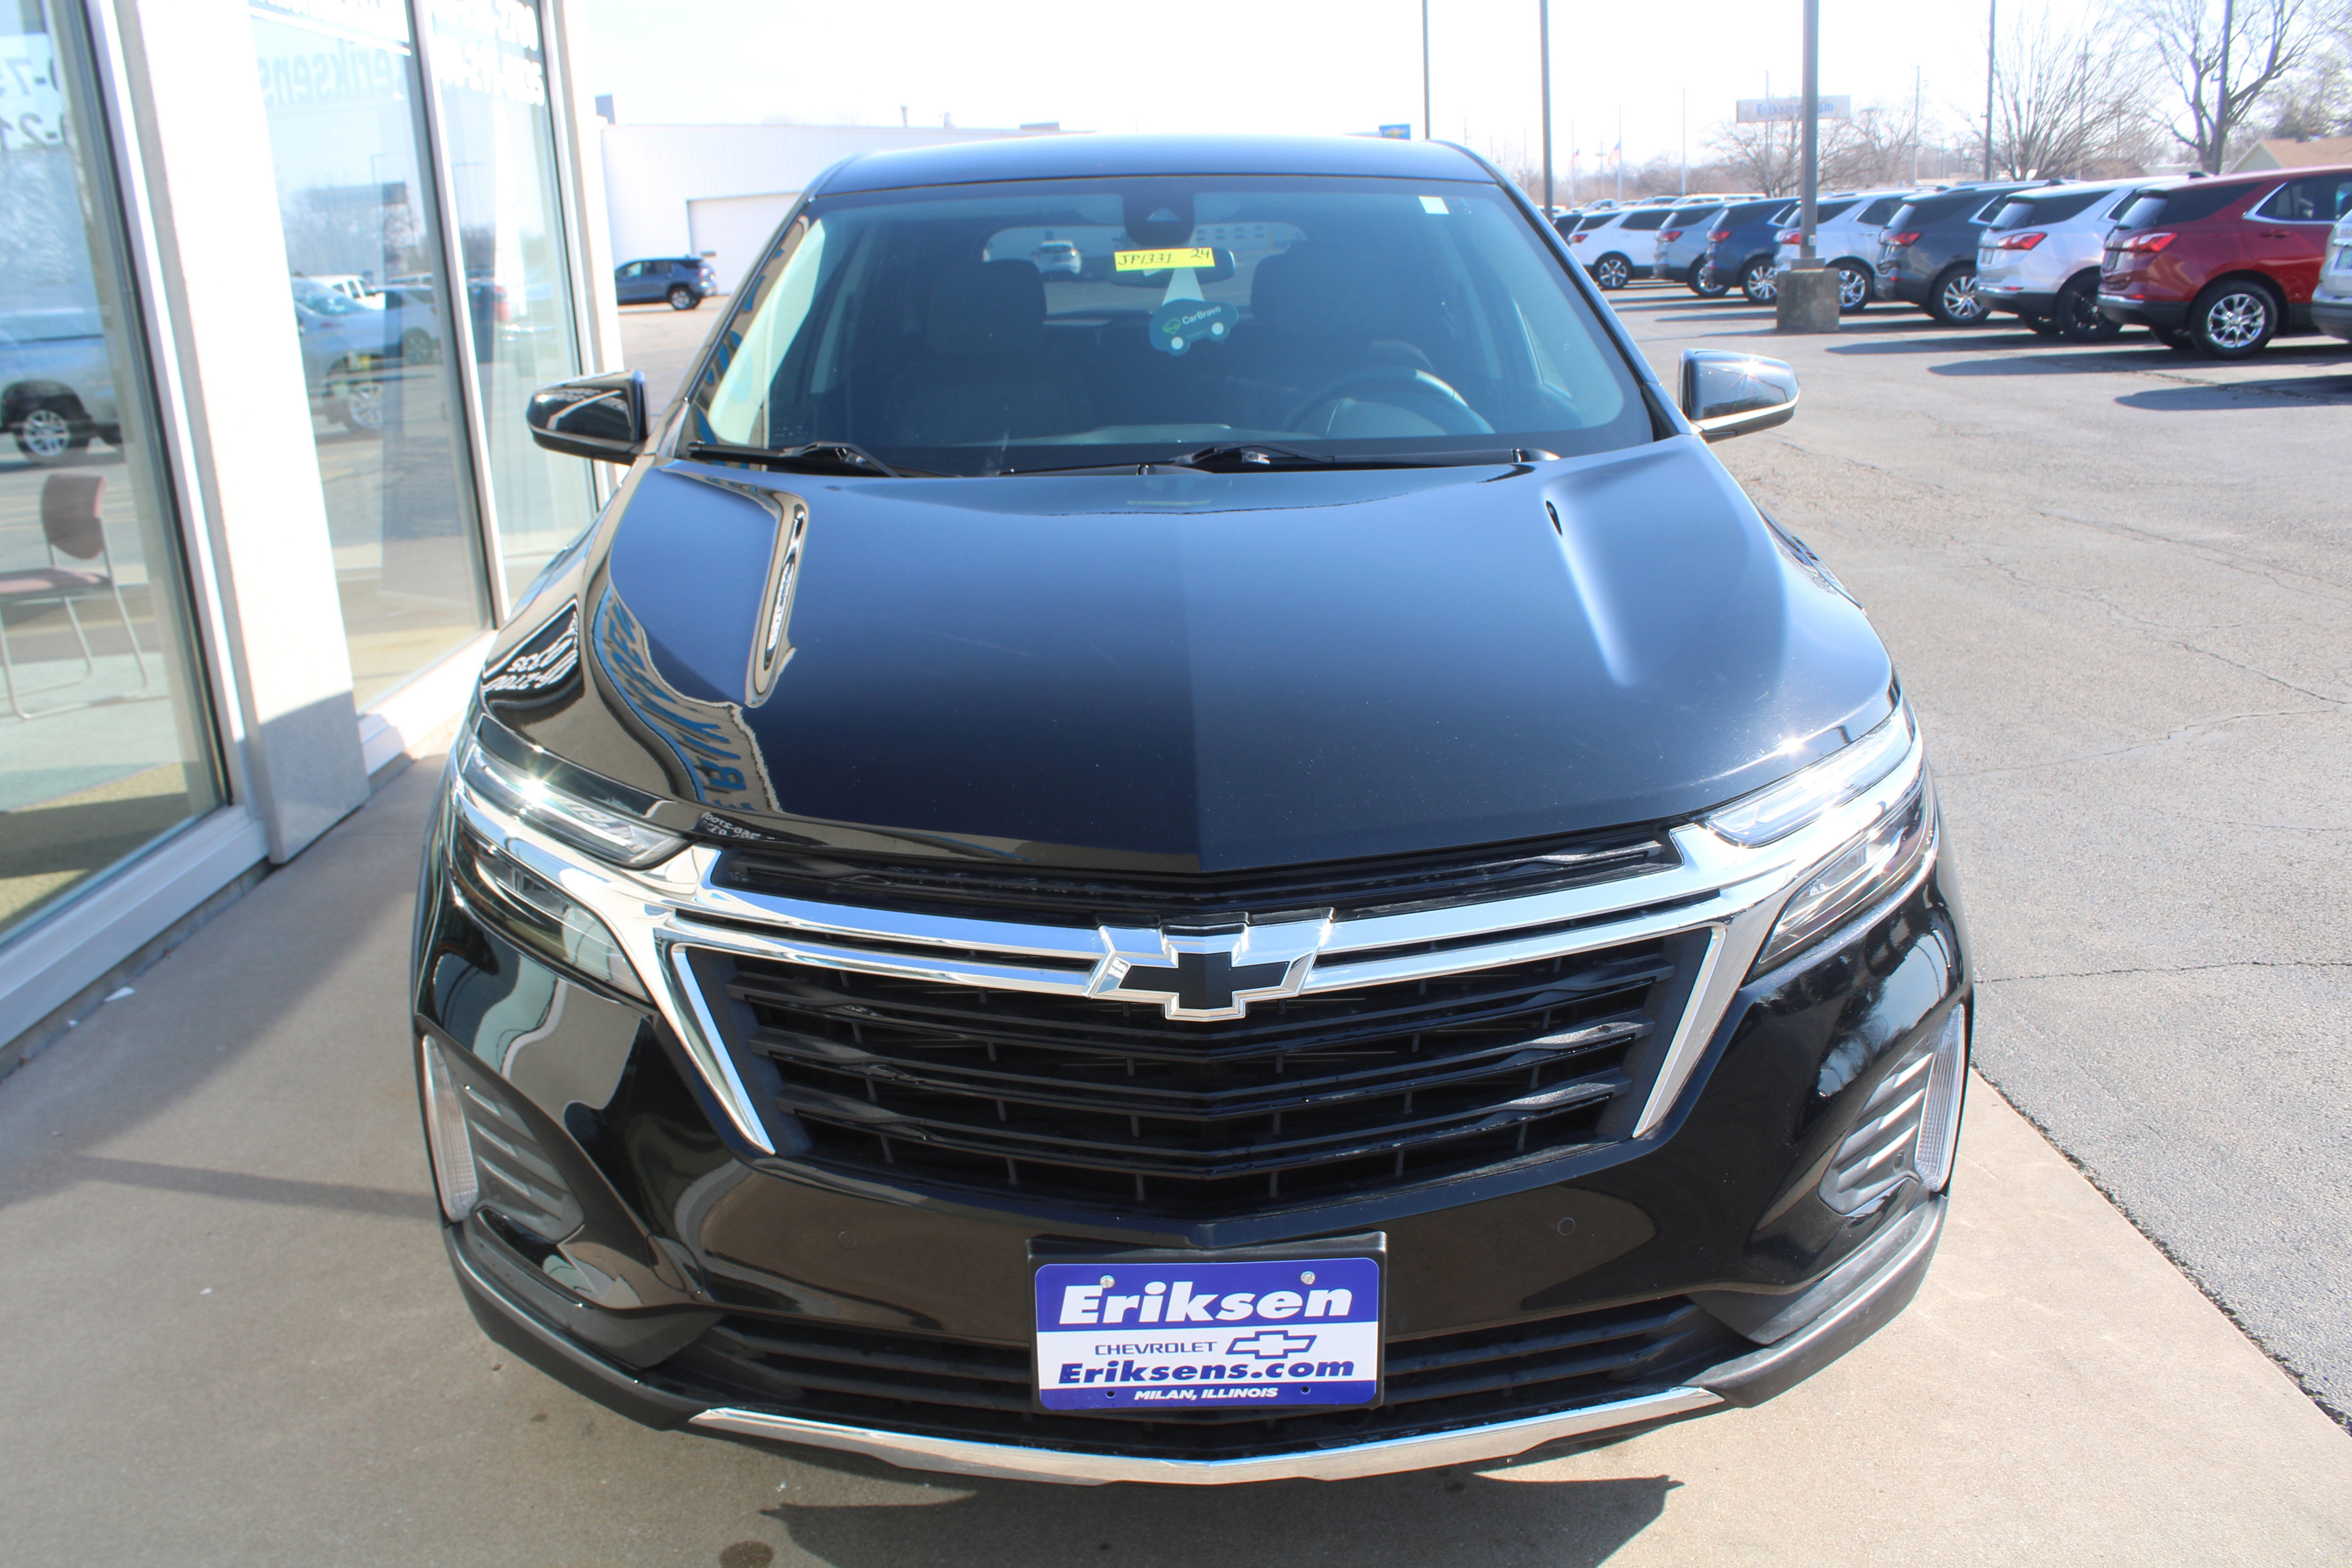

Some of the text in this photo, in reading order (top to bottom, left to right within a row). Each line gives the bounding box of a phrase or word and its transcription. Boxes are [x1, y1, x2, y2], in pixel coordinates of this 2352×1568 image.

[1190, 248, 1210, 258] 24
[1182, 306, 1221, 325] CarBravo
[1059, 1281, 1353, 1324] Eriksen
[1095, 1341, 1217, 1356] CHEVROLET
[1058, 1360, 1355, 1384] Eriksens.com
[1134, 1387, 1278, 1401] MILAN, ILLINOIS
